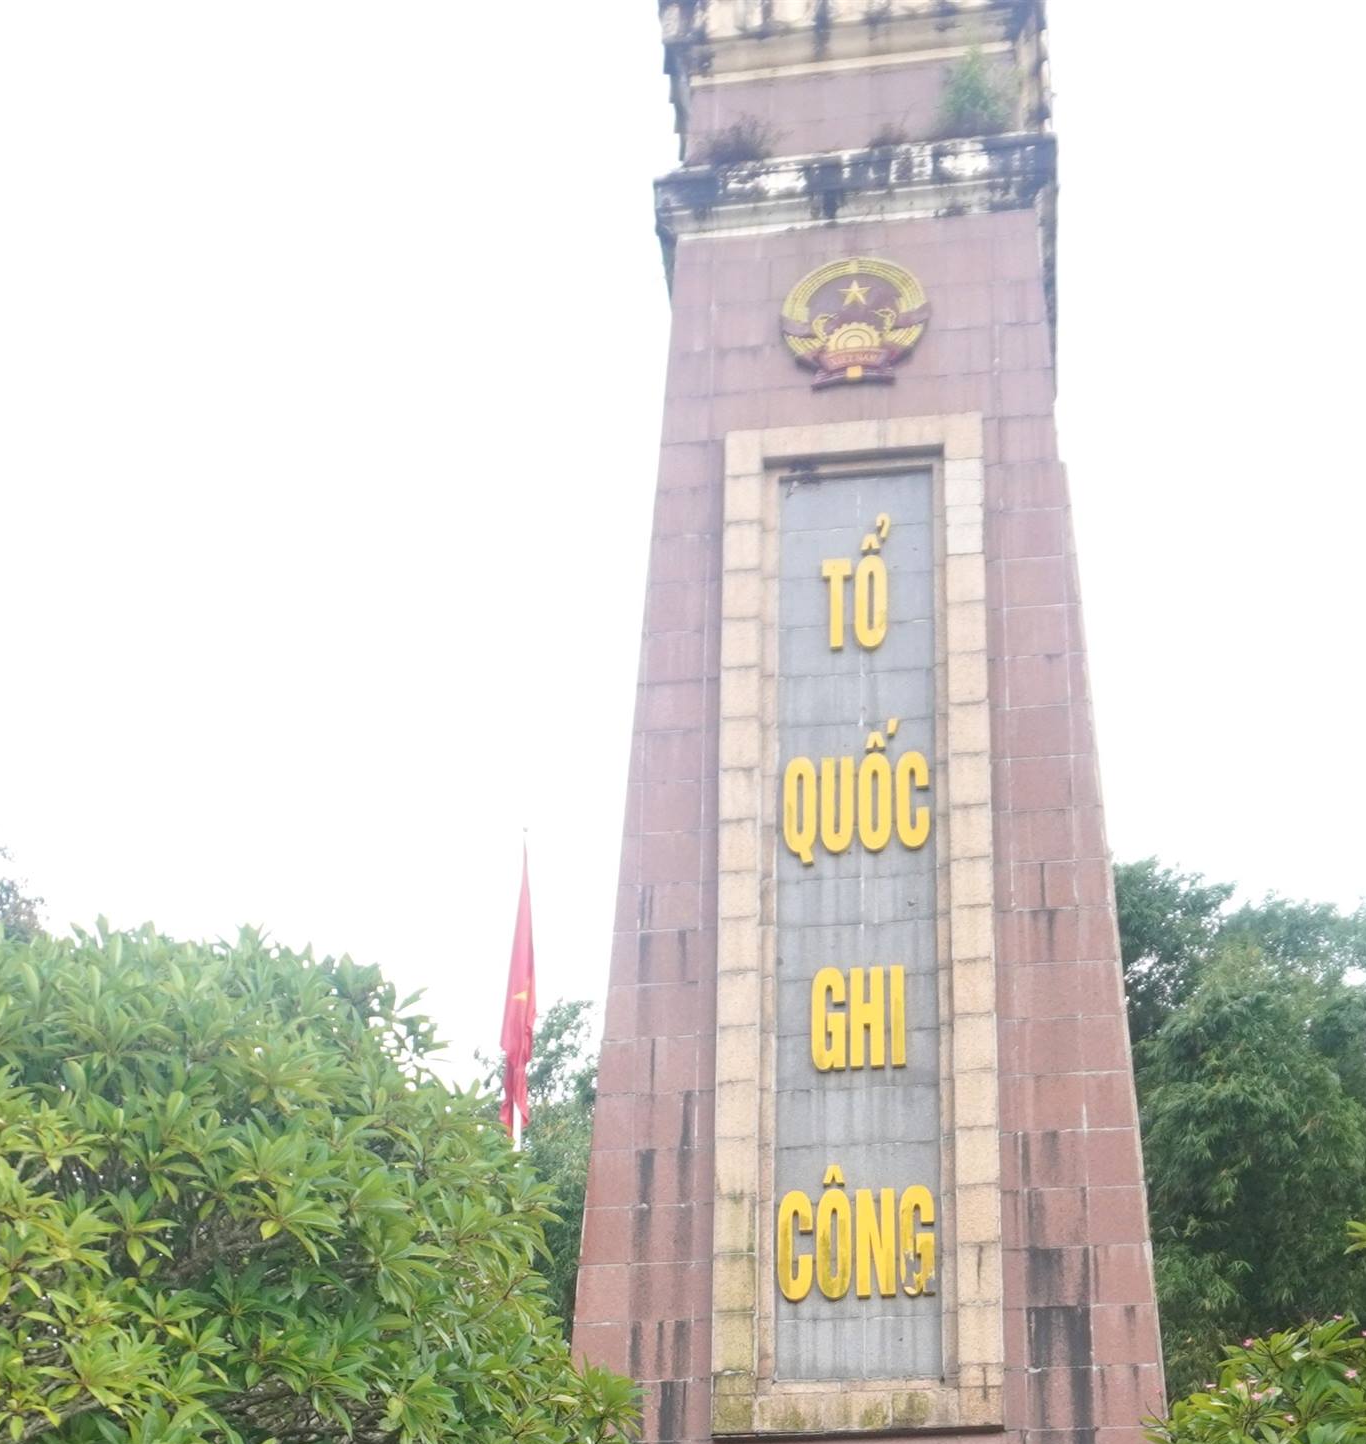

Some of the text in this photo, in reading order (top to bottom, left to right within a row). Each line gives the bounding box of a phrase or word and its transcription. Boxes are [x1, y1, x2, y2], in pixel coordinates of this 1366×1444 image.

[821, 511, 891, 650] TỔ
[784, 717, 931, 866] QUỐC
[811, 965, 906, 1073] GHI
[778, 1164, 936, 1302] CÔNG
